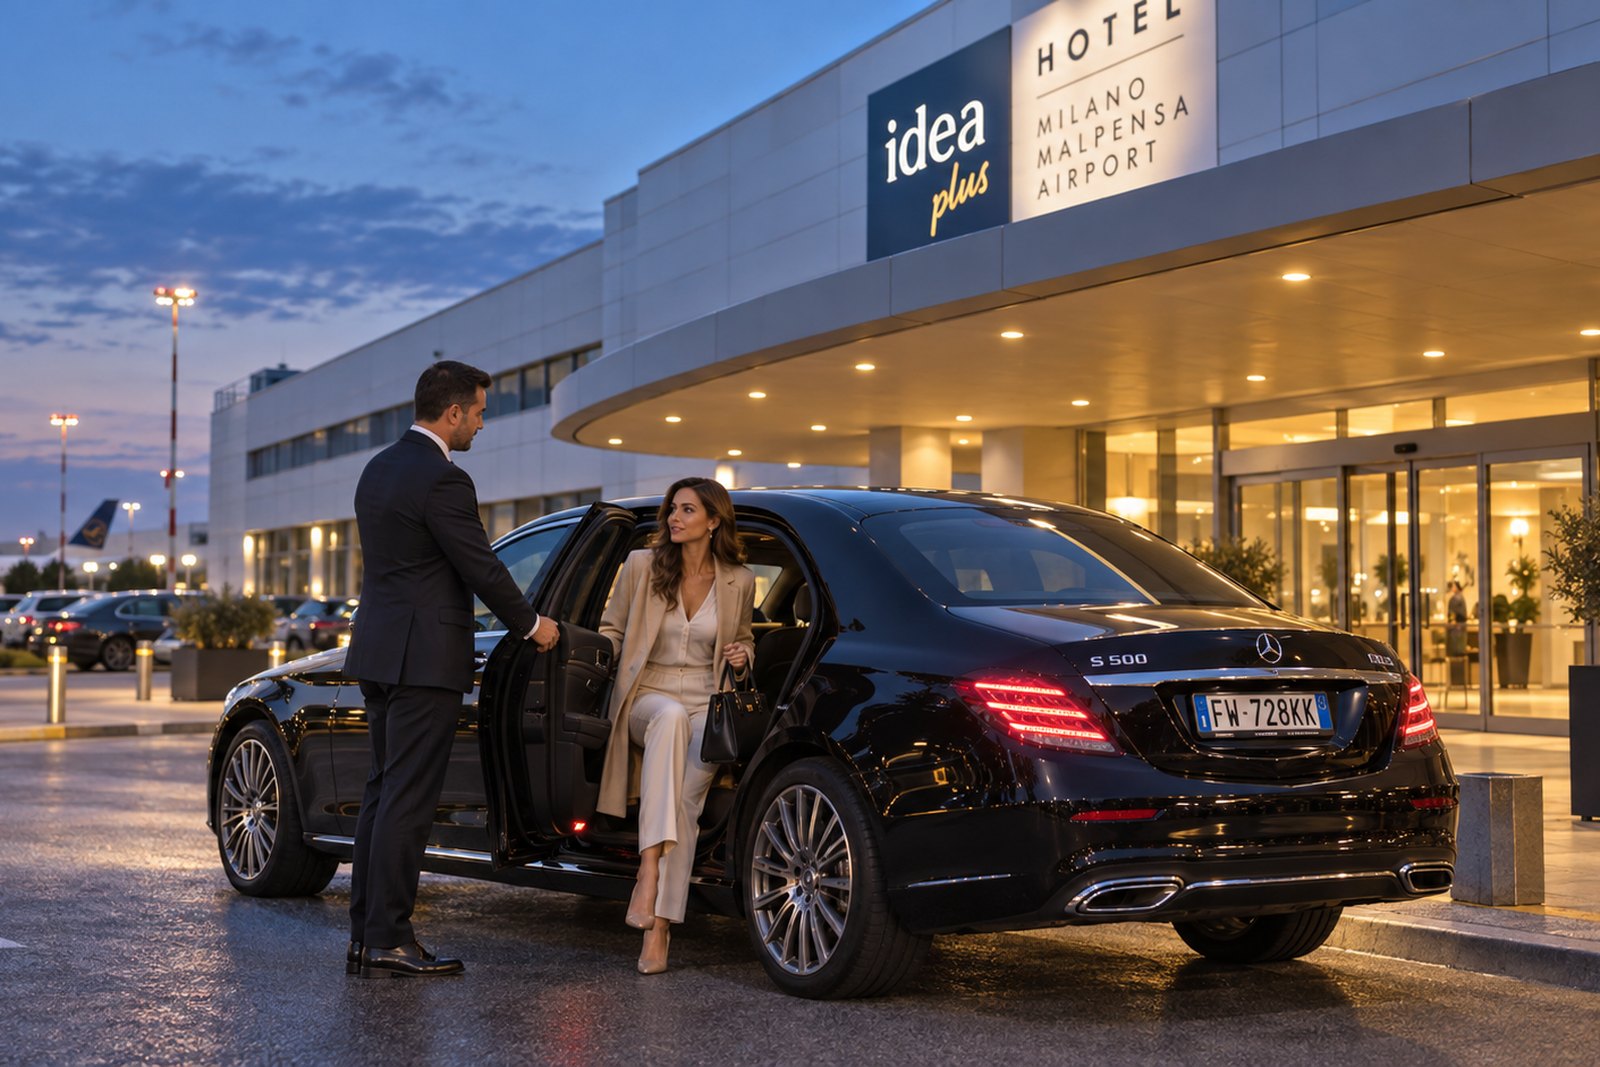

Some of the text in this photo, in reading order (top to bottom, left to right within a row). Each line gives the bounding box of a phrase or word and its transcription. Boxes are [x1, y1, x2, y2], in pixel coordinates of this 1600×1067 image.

[1038, 0, 1181, 77] HOTEL
[885, 100, 986, 183] idea
[1037, 77, 1145, 138] MILANO
[1037, 95, 1189, 169] MALPENSA
[930, 161, 989, 237] plus
[1037, 140, 1157, 200] AIRPORT
[1090, 653, 1148, 667] S 500
